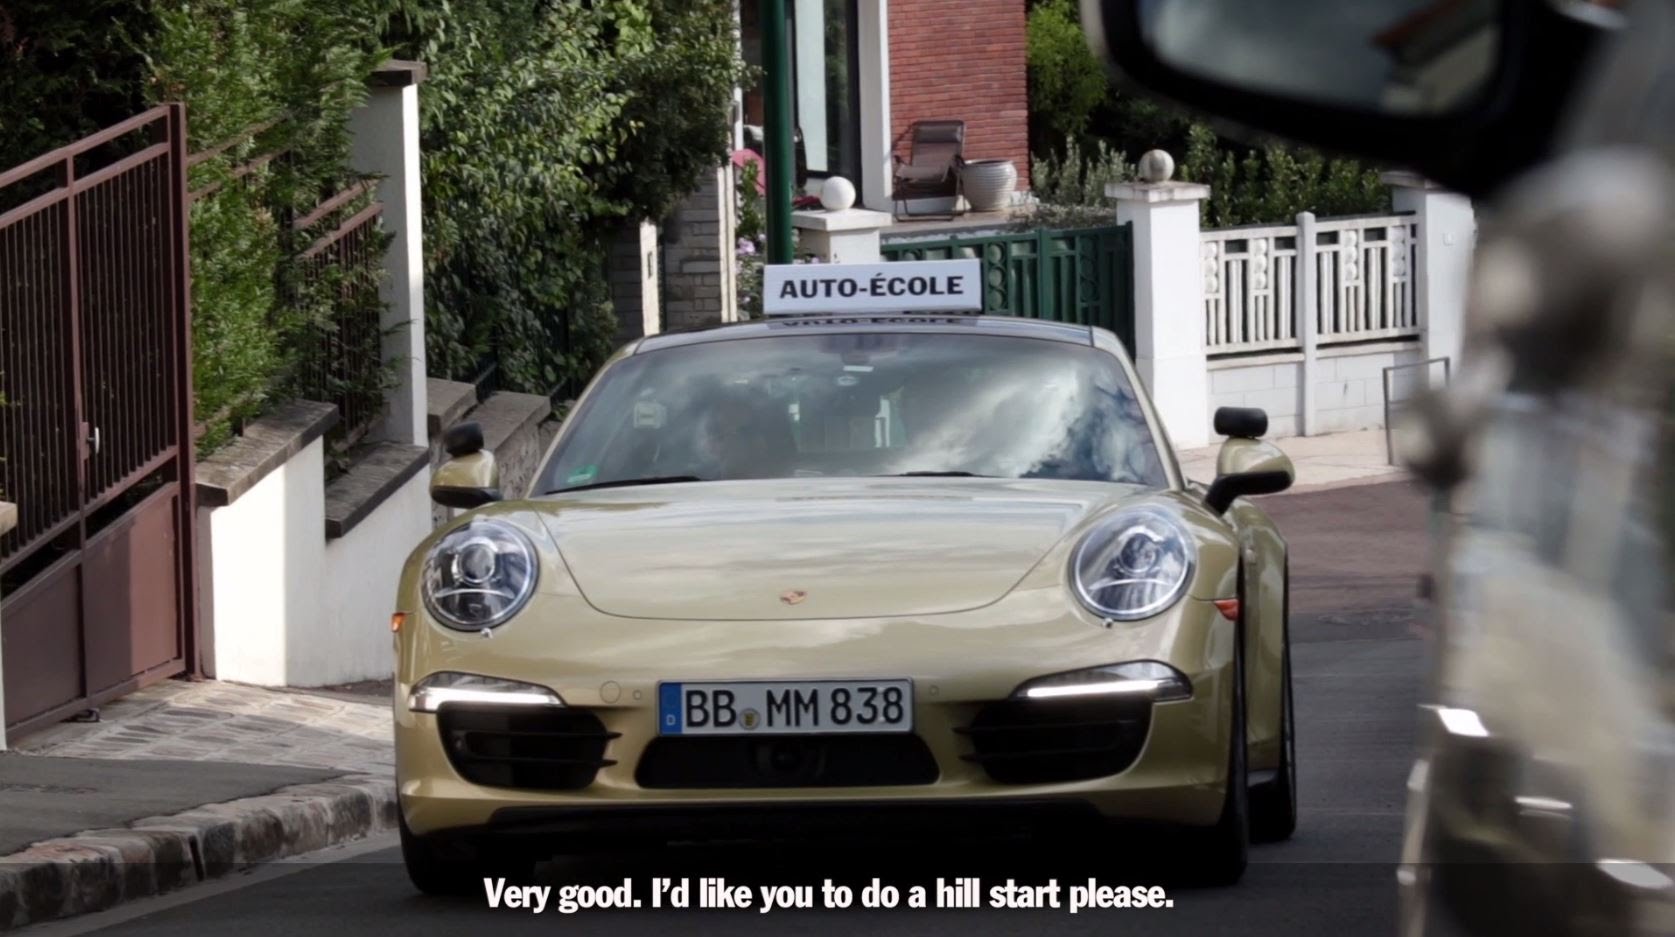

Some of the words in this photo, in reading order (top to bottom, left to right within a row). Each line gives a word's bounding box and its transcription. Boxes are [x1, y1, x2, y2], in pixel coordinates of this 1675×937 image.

[779, 272, 964, 299] AUTO-ÉCOLE
[666, 713, 677, 726] D
[685, 689, 737, 728] BB
[766, 688, 820, 728] MM
[829, 686, 905, 726] 838
